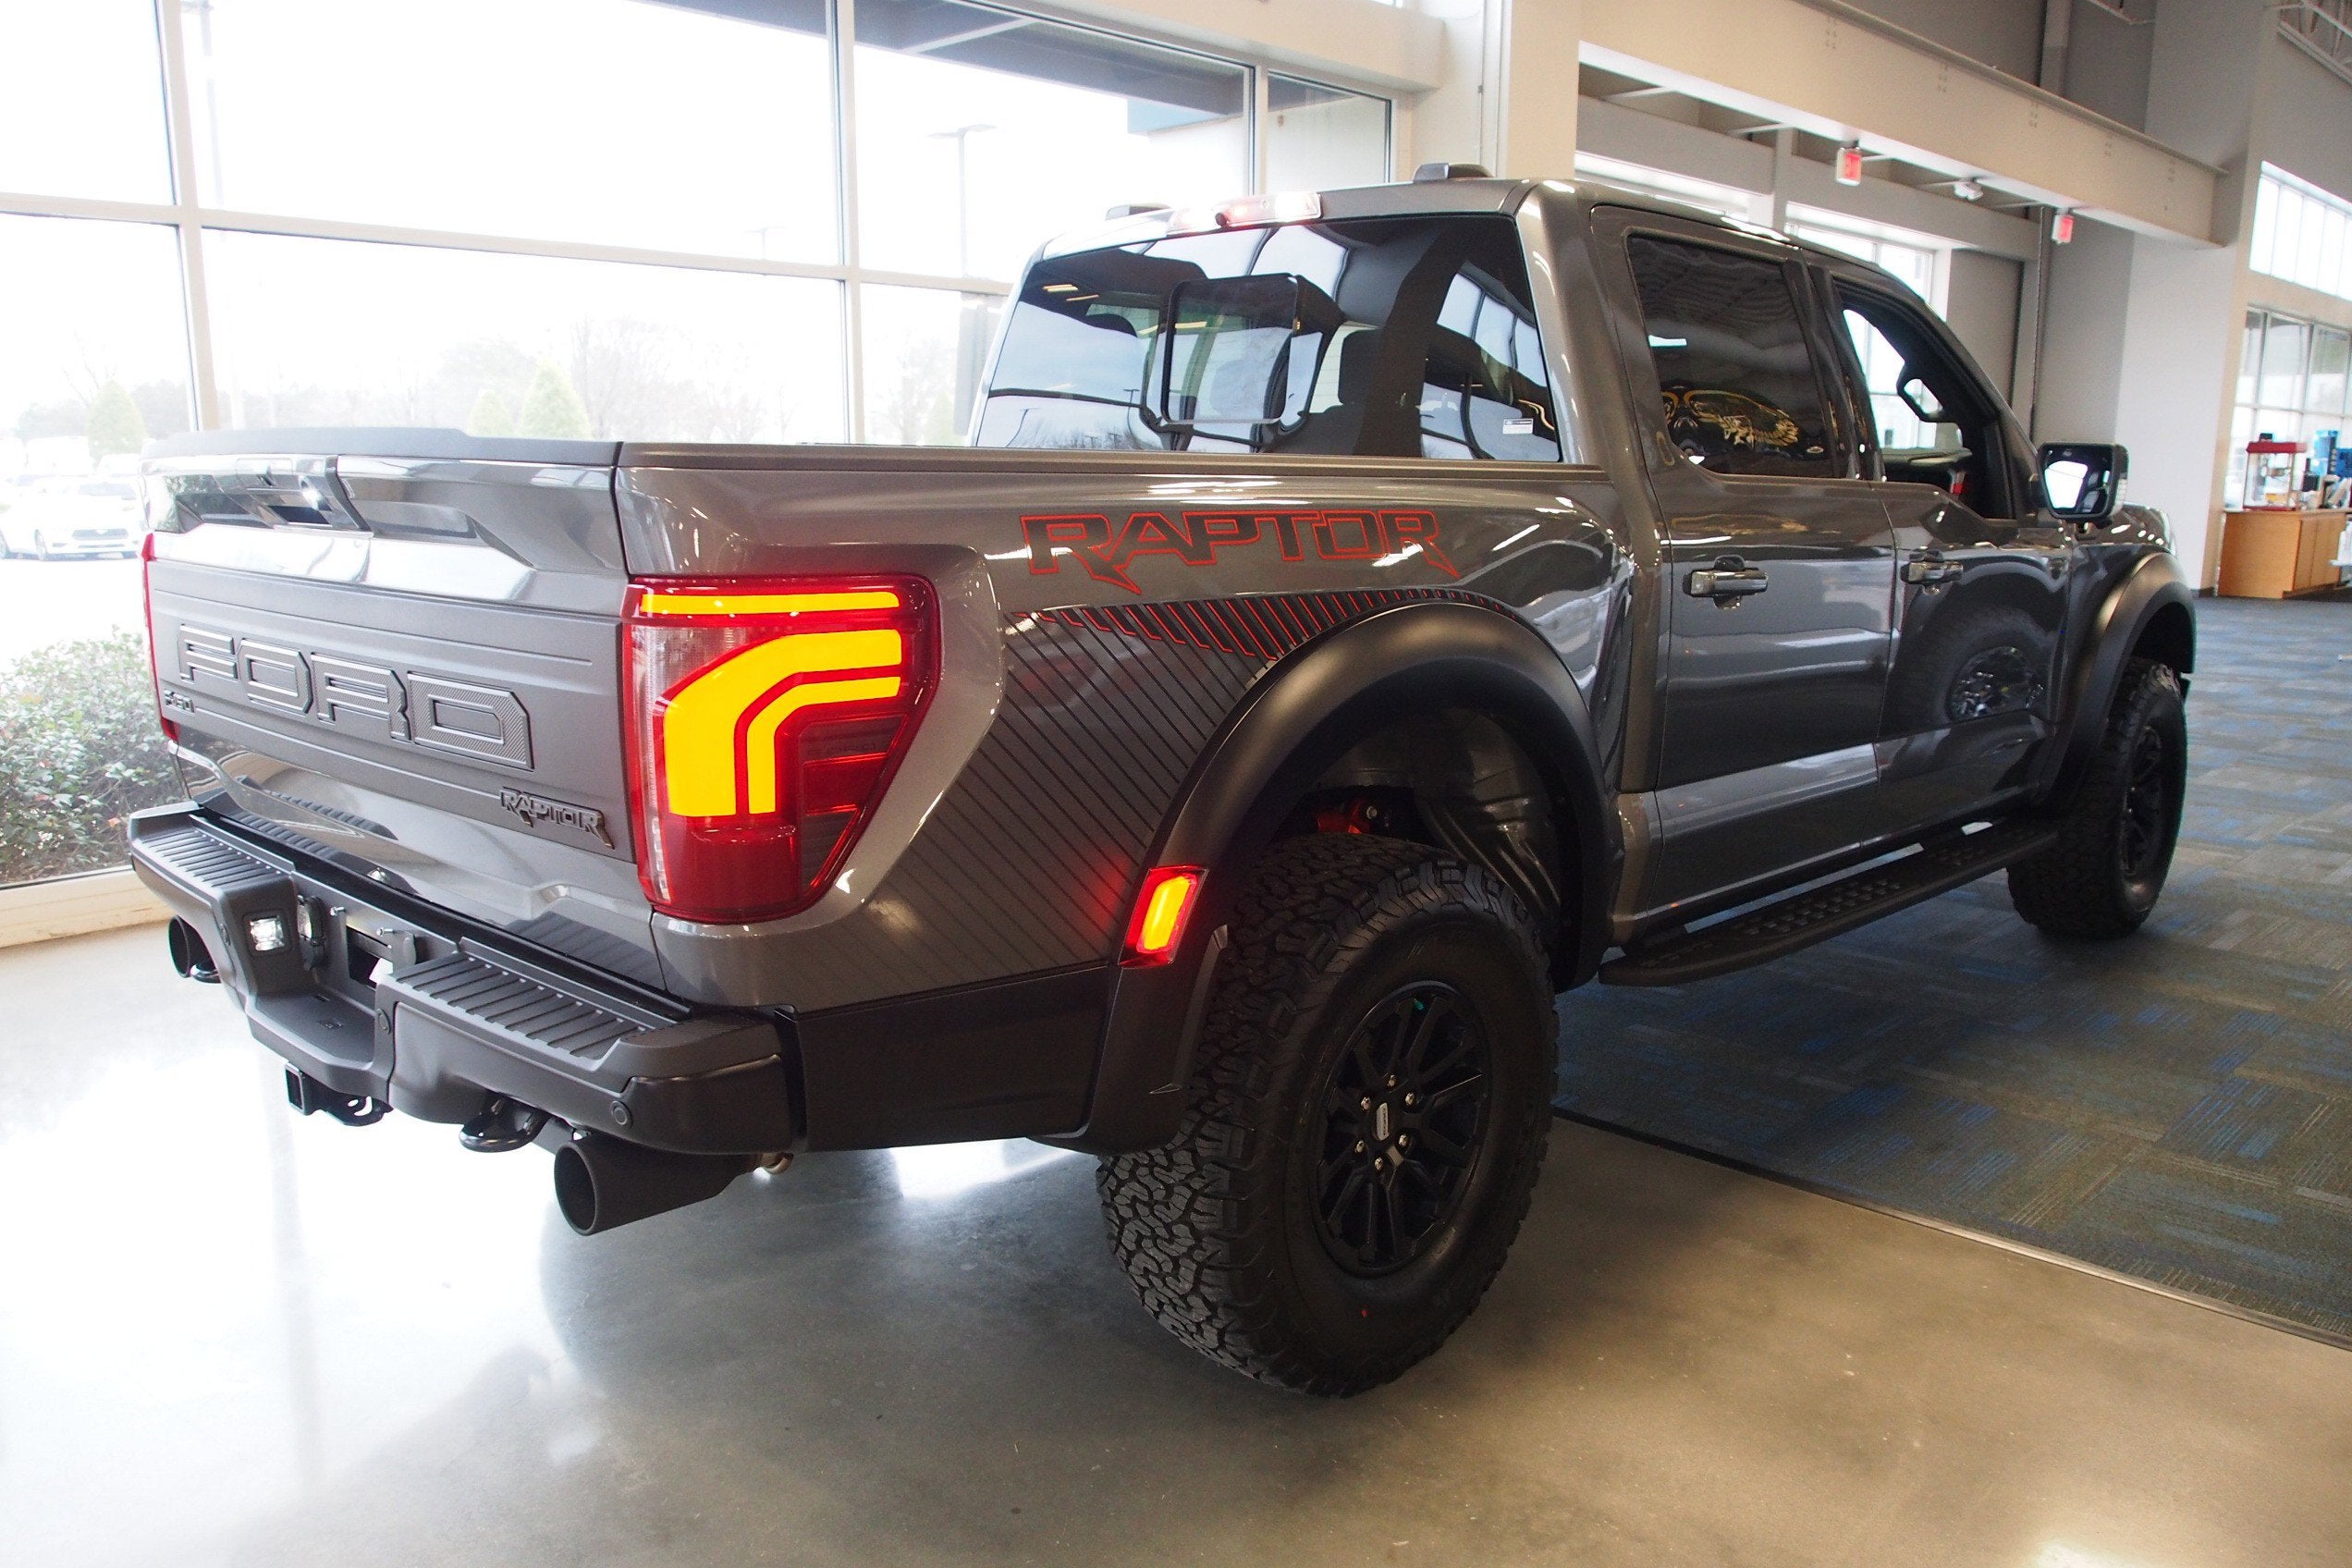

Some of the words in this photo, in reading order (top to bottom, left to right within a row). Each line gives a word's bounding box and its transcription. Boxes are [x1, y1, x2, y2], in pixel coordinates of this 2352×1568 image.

[1020, 508, 1460, 594] RAPTOR
[178, 624, 534, 771] FORD
[499, 786, 615, 850] RAPTOR
